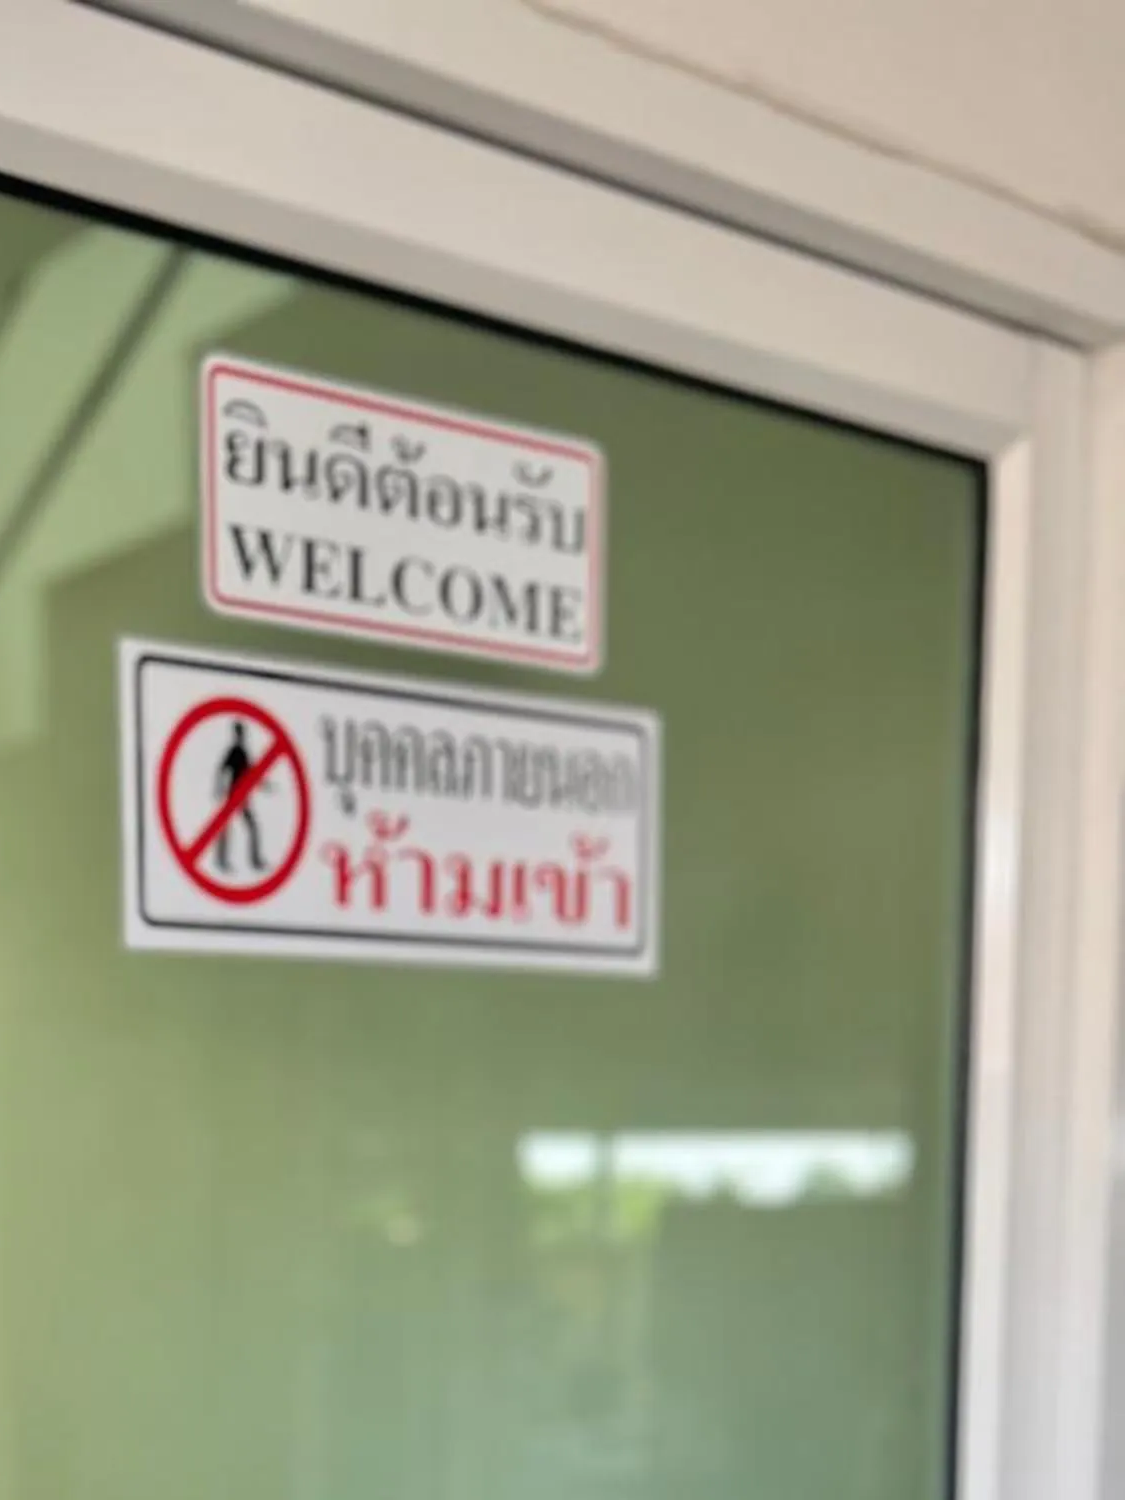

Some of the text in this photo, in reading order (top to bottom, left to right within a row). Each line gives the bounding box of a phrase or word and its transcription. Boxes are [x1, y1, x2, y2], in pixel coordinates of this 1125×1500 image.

[223, 398, 585, 558] ยินดีต้อนรับ
[229, 522, 583, 643] WELCOME
[321, 714, 637, 816] บุคคลภายนอก
[323, 810, 632, 931] ห้ามเข้า
